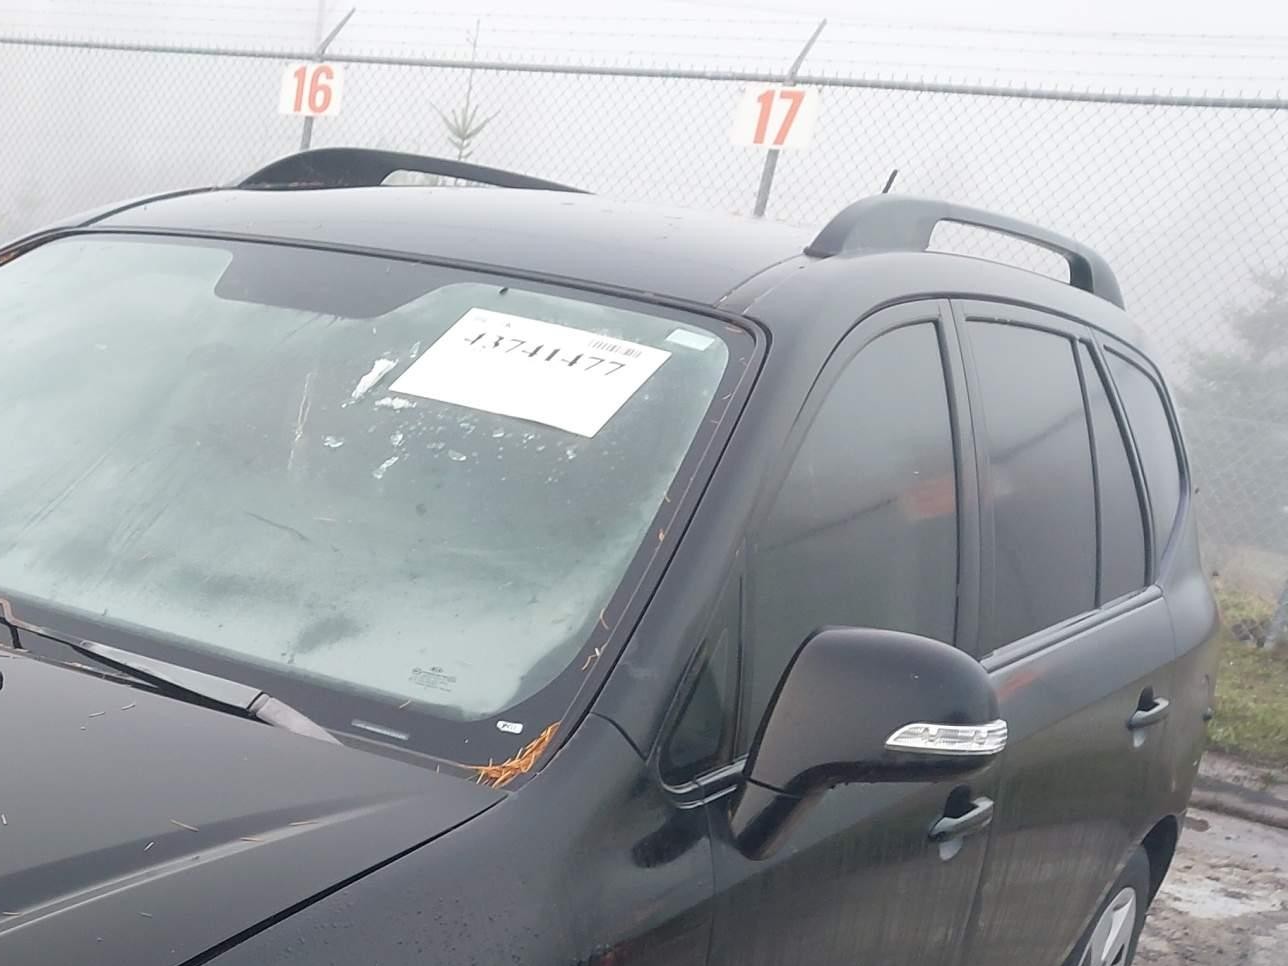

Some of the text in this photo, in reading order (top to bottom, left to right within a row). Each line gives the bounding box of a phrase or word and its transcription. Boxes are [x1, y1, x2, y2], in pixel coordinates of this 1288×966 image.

[292, 65, 334, 114] 16
[753, 89, 806, 145] 17
[464, 332, 626, 376] 43741477
